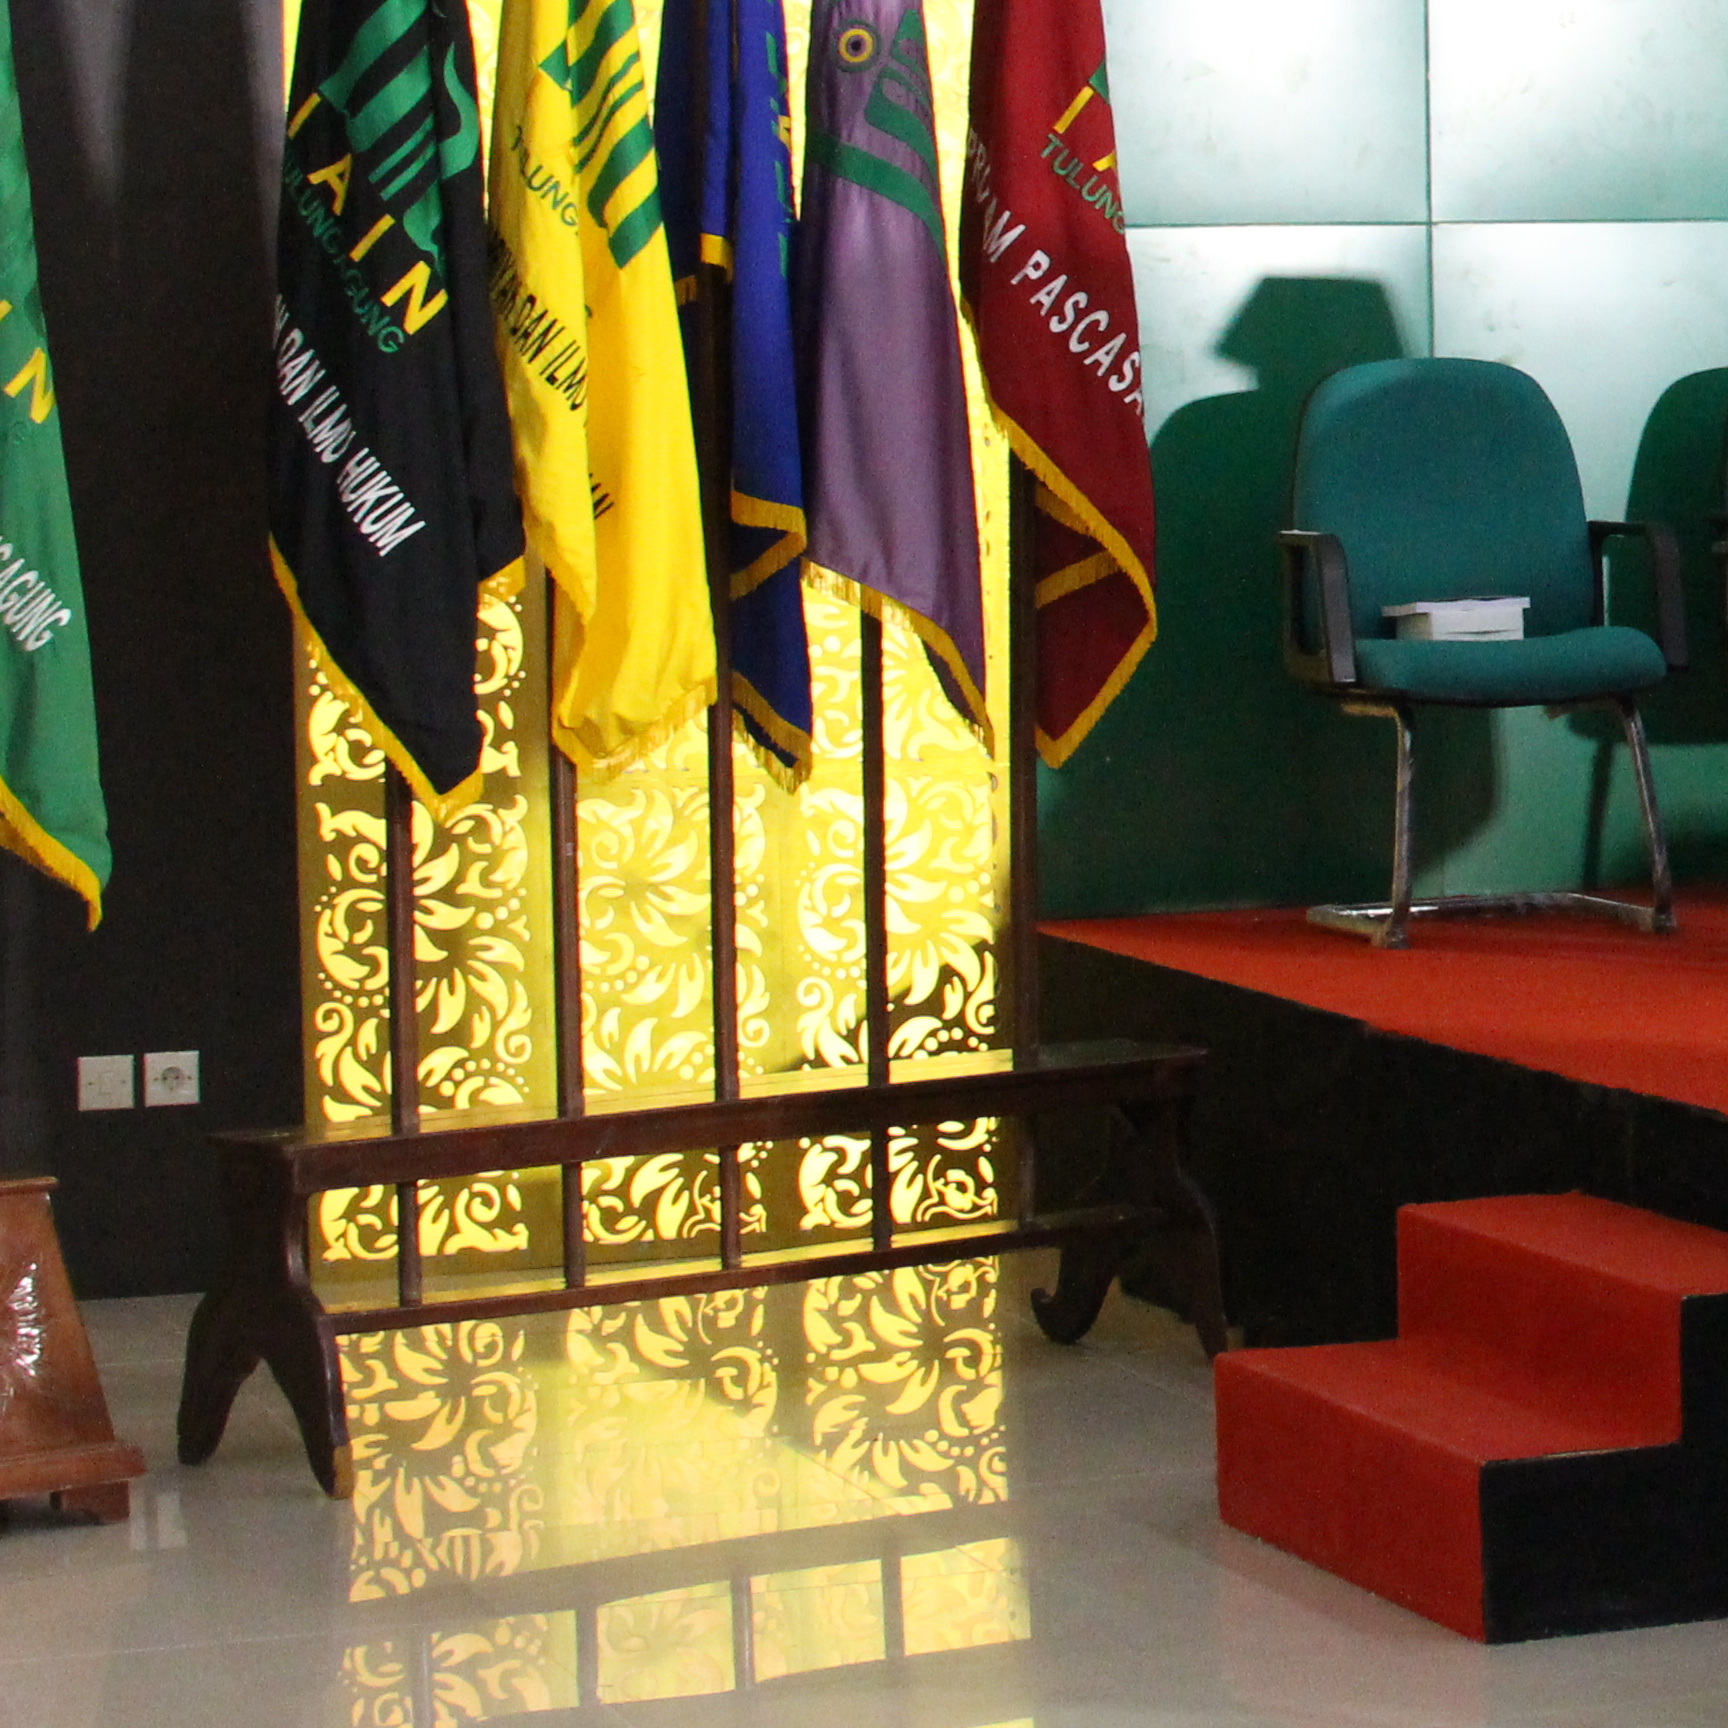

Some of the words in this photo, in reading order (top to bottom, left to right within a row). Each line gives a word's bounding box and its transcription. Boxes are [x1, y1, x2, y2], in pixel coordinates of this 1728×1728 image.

[276, 327, 328, 406] DAN
[297, 384, 357, 464] ILMU
[335, 446, 427, 557] HUKUM
